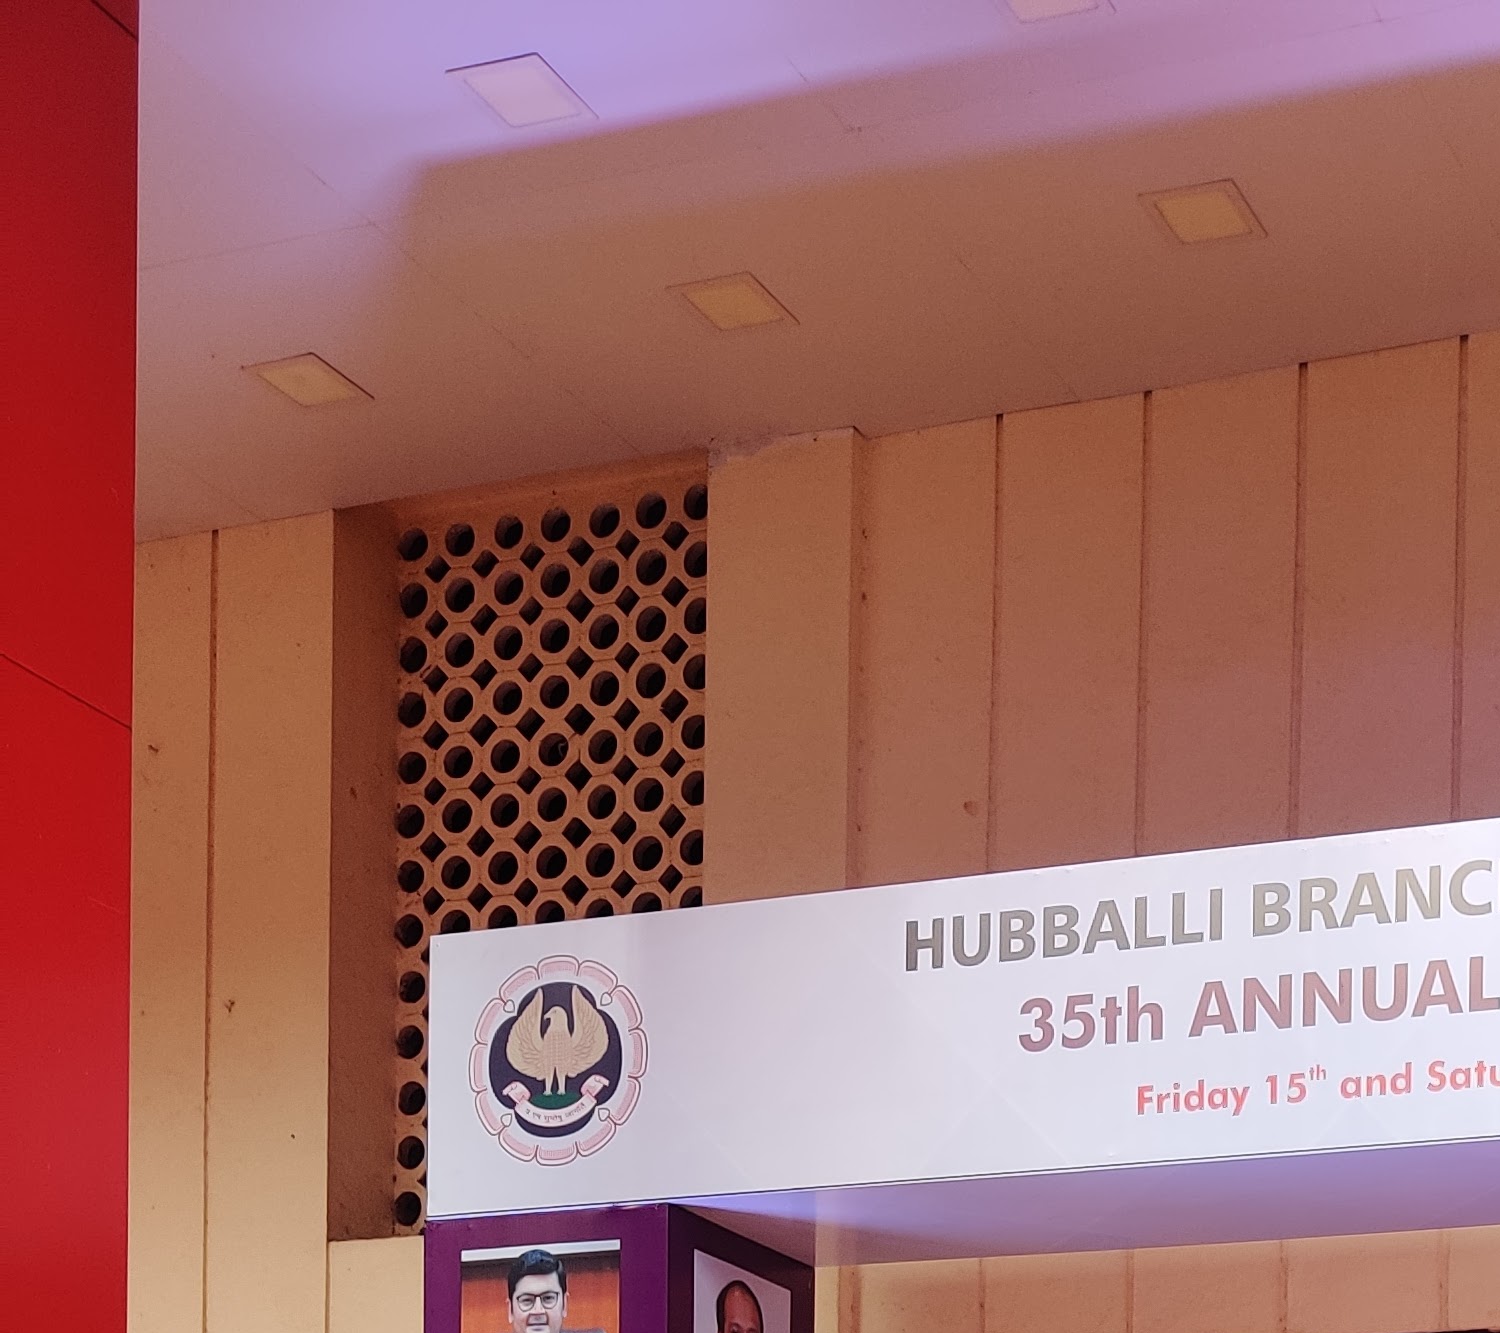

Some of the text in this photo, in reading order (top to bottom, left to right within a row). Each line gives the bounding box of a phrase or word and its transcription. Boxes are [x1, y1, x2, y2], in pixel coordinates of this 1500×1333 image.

[905, 889, 1223, 972] HUBBALLI
[1018, 986, 1164, 1053] 35th
[1188, 958, 1500, 1038] ANNUAL
[1136, 1082, 1250, 1117] Friday
[1339, 1067, 1413, 1100] and
